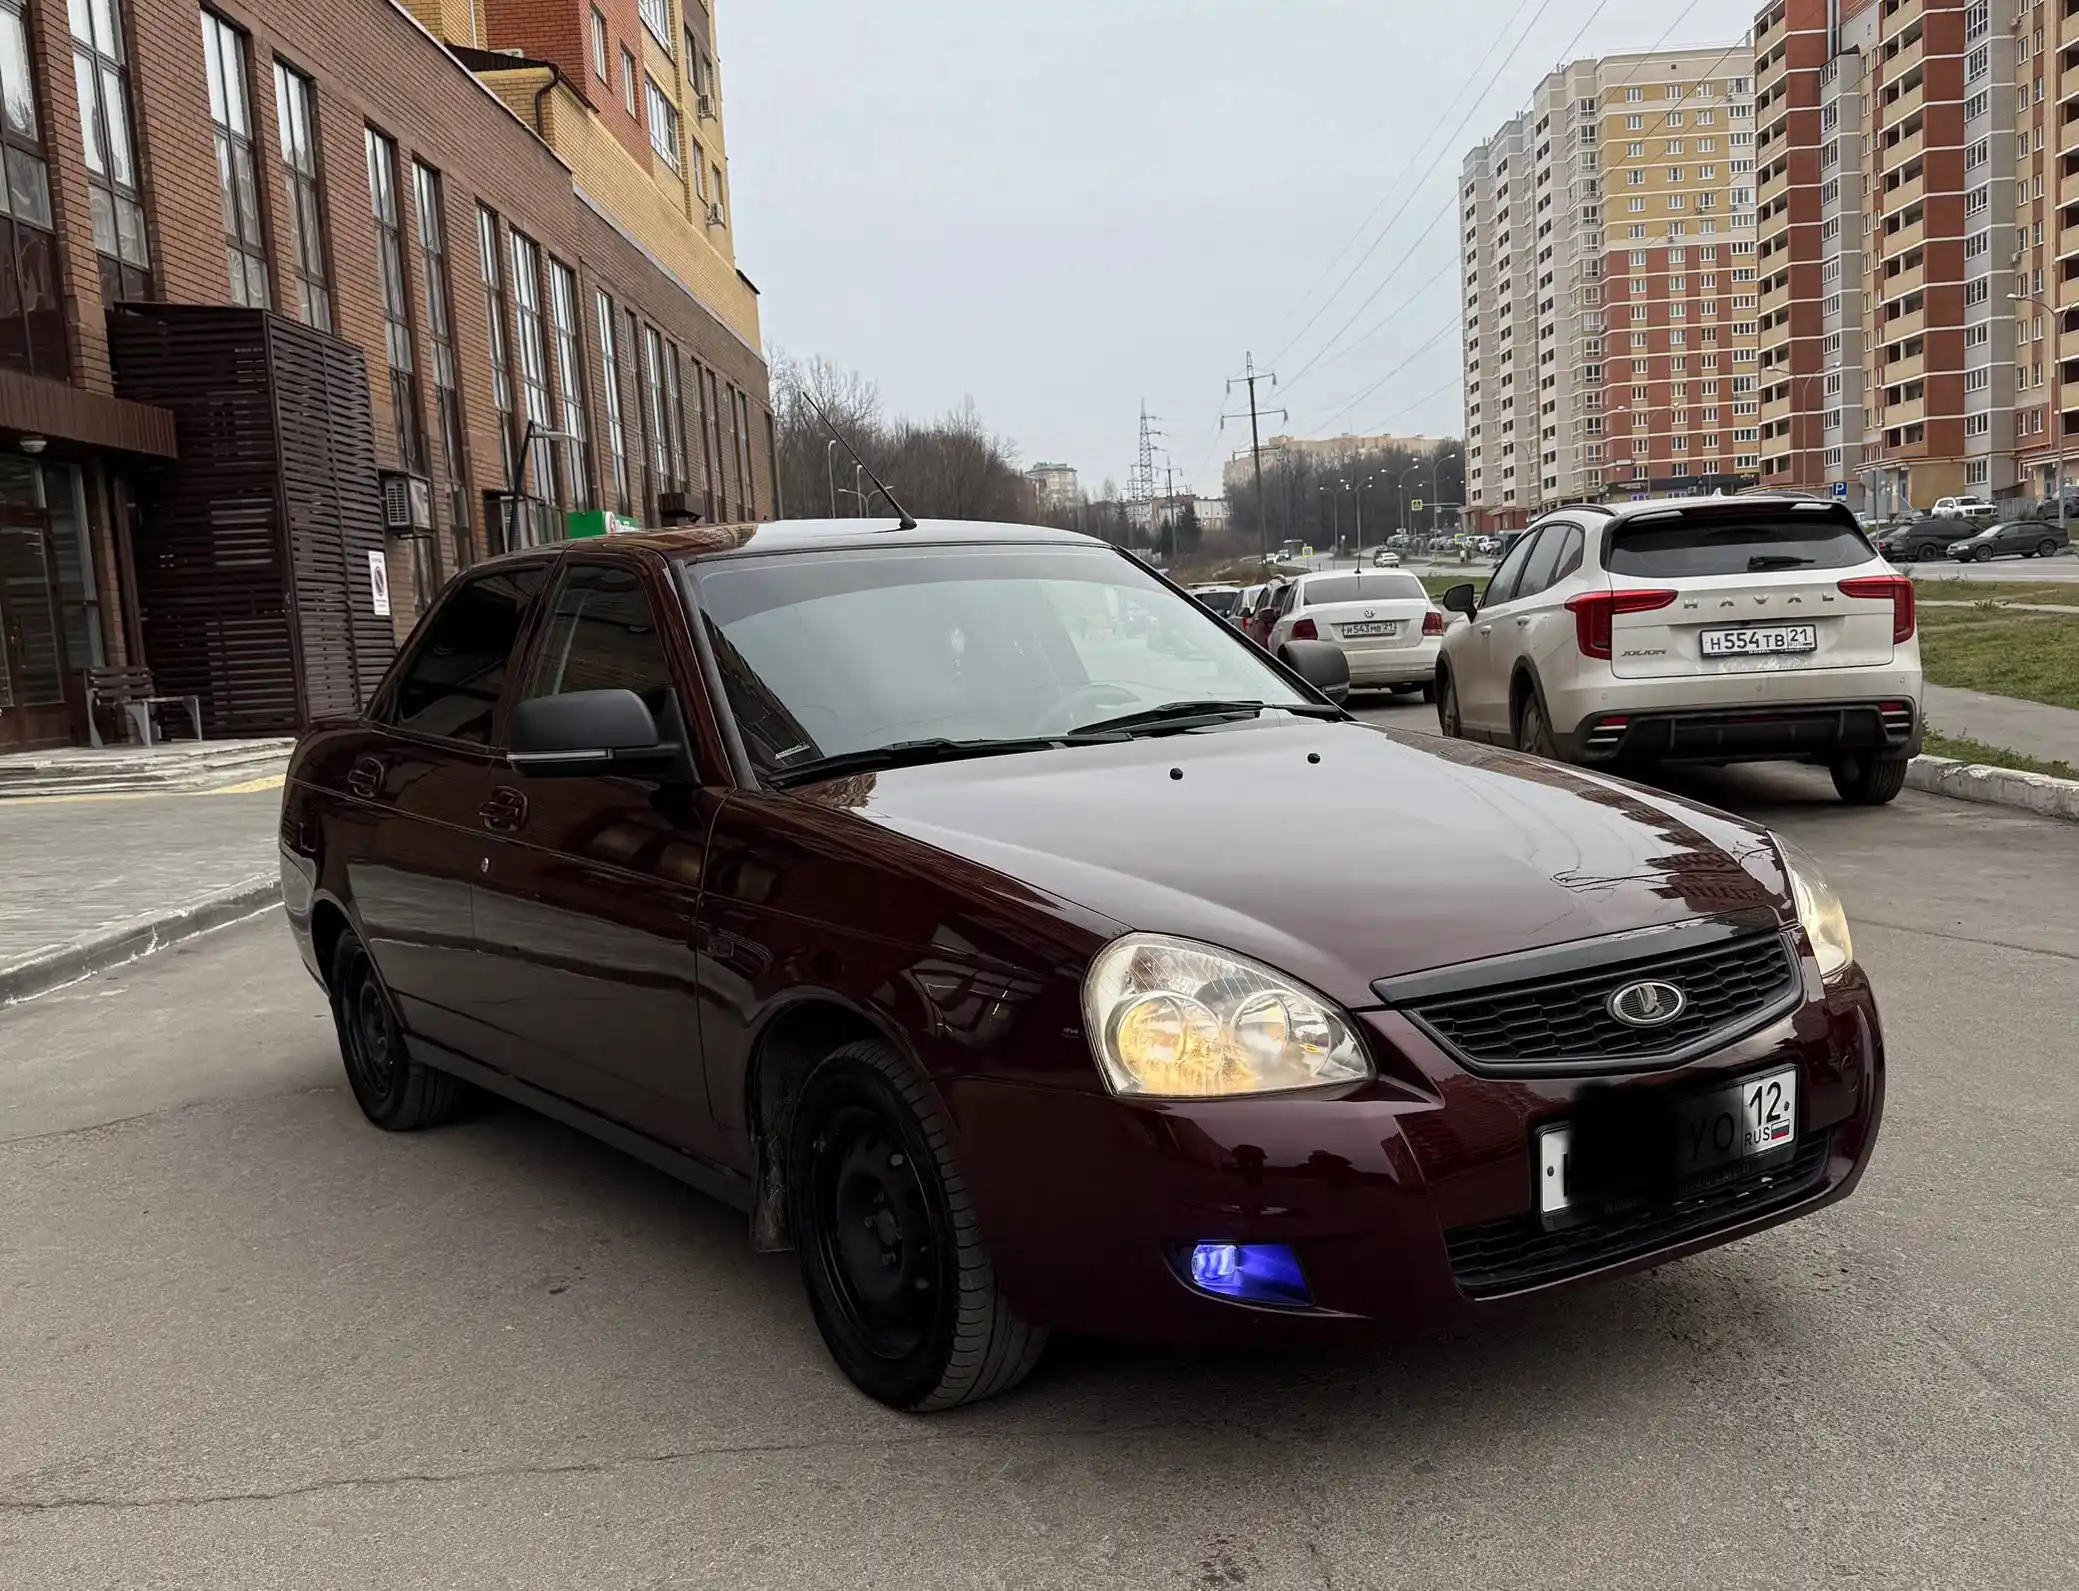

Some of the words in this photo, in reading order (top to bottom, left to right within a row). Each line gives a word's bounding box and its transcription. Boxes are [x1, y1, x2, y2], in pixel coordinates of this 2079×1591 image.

[1683, 592, 1835, 609] HAVAL
[1710, 631, 1785, 651] Н554ТВ
[1789, 628, 1808, 642] 21
[1748, 1081, 1782, 1127] 12
[1744, 1126, 1770, 1148] RUS
